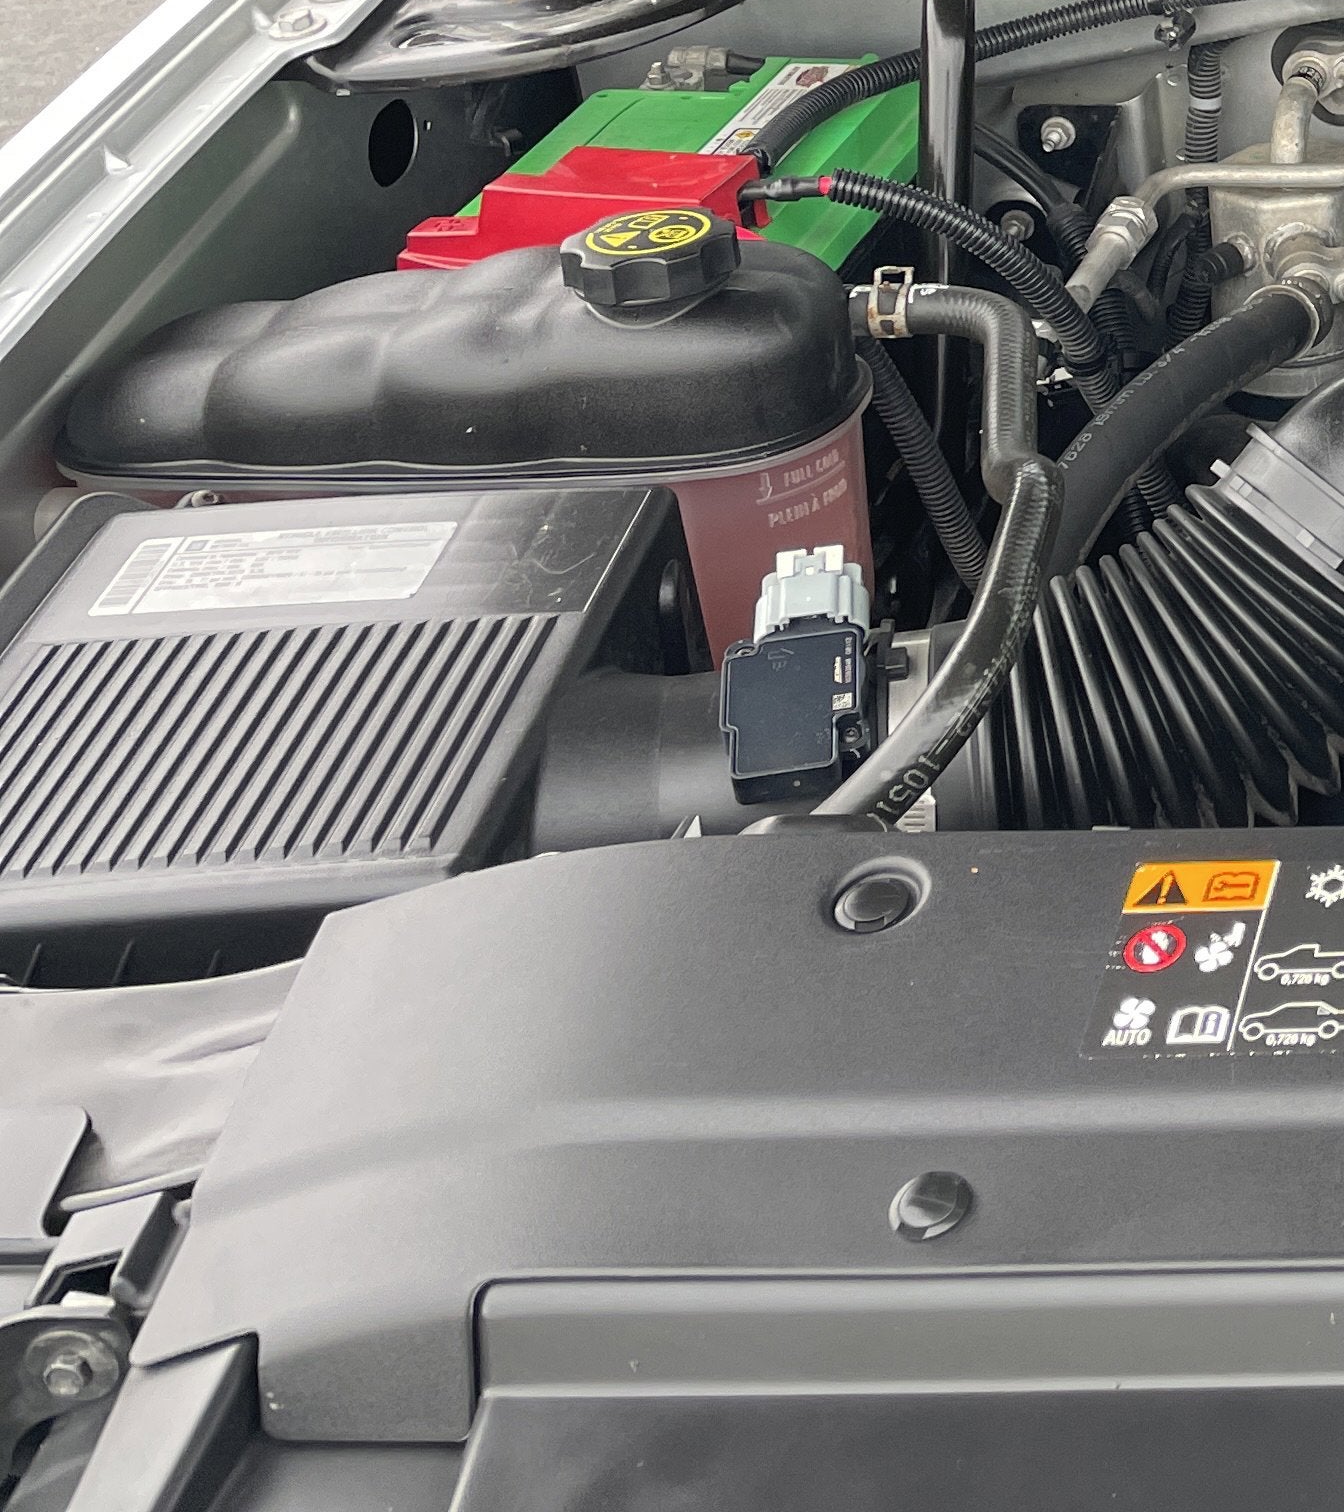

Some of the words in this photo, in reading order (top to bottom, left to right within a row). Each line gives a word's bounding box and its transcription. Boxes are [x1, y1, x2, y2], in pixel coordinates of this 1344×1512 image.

[784, 464, 814, 488] FULL
[768, 501, 810, 528] PLEIN
[810, 493, 821, 513] À
[1314, 973, 1330, 986] kg
[1101, 1028, 1153, 1047] AUTO
[1299, 1033, 1316, 1046] kg
